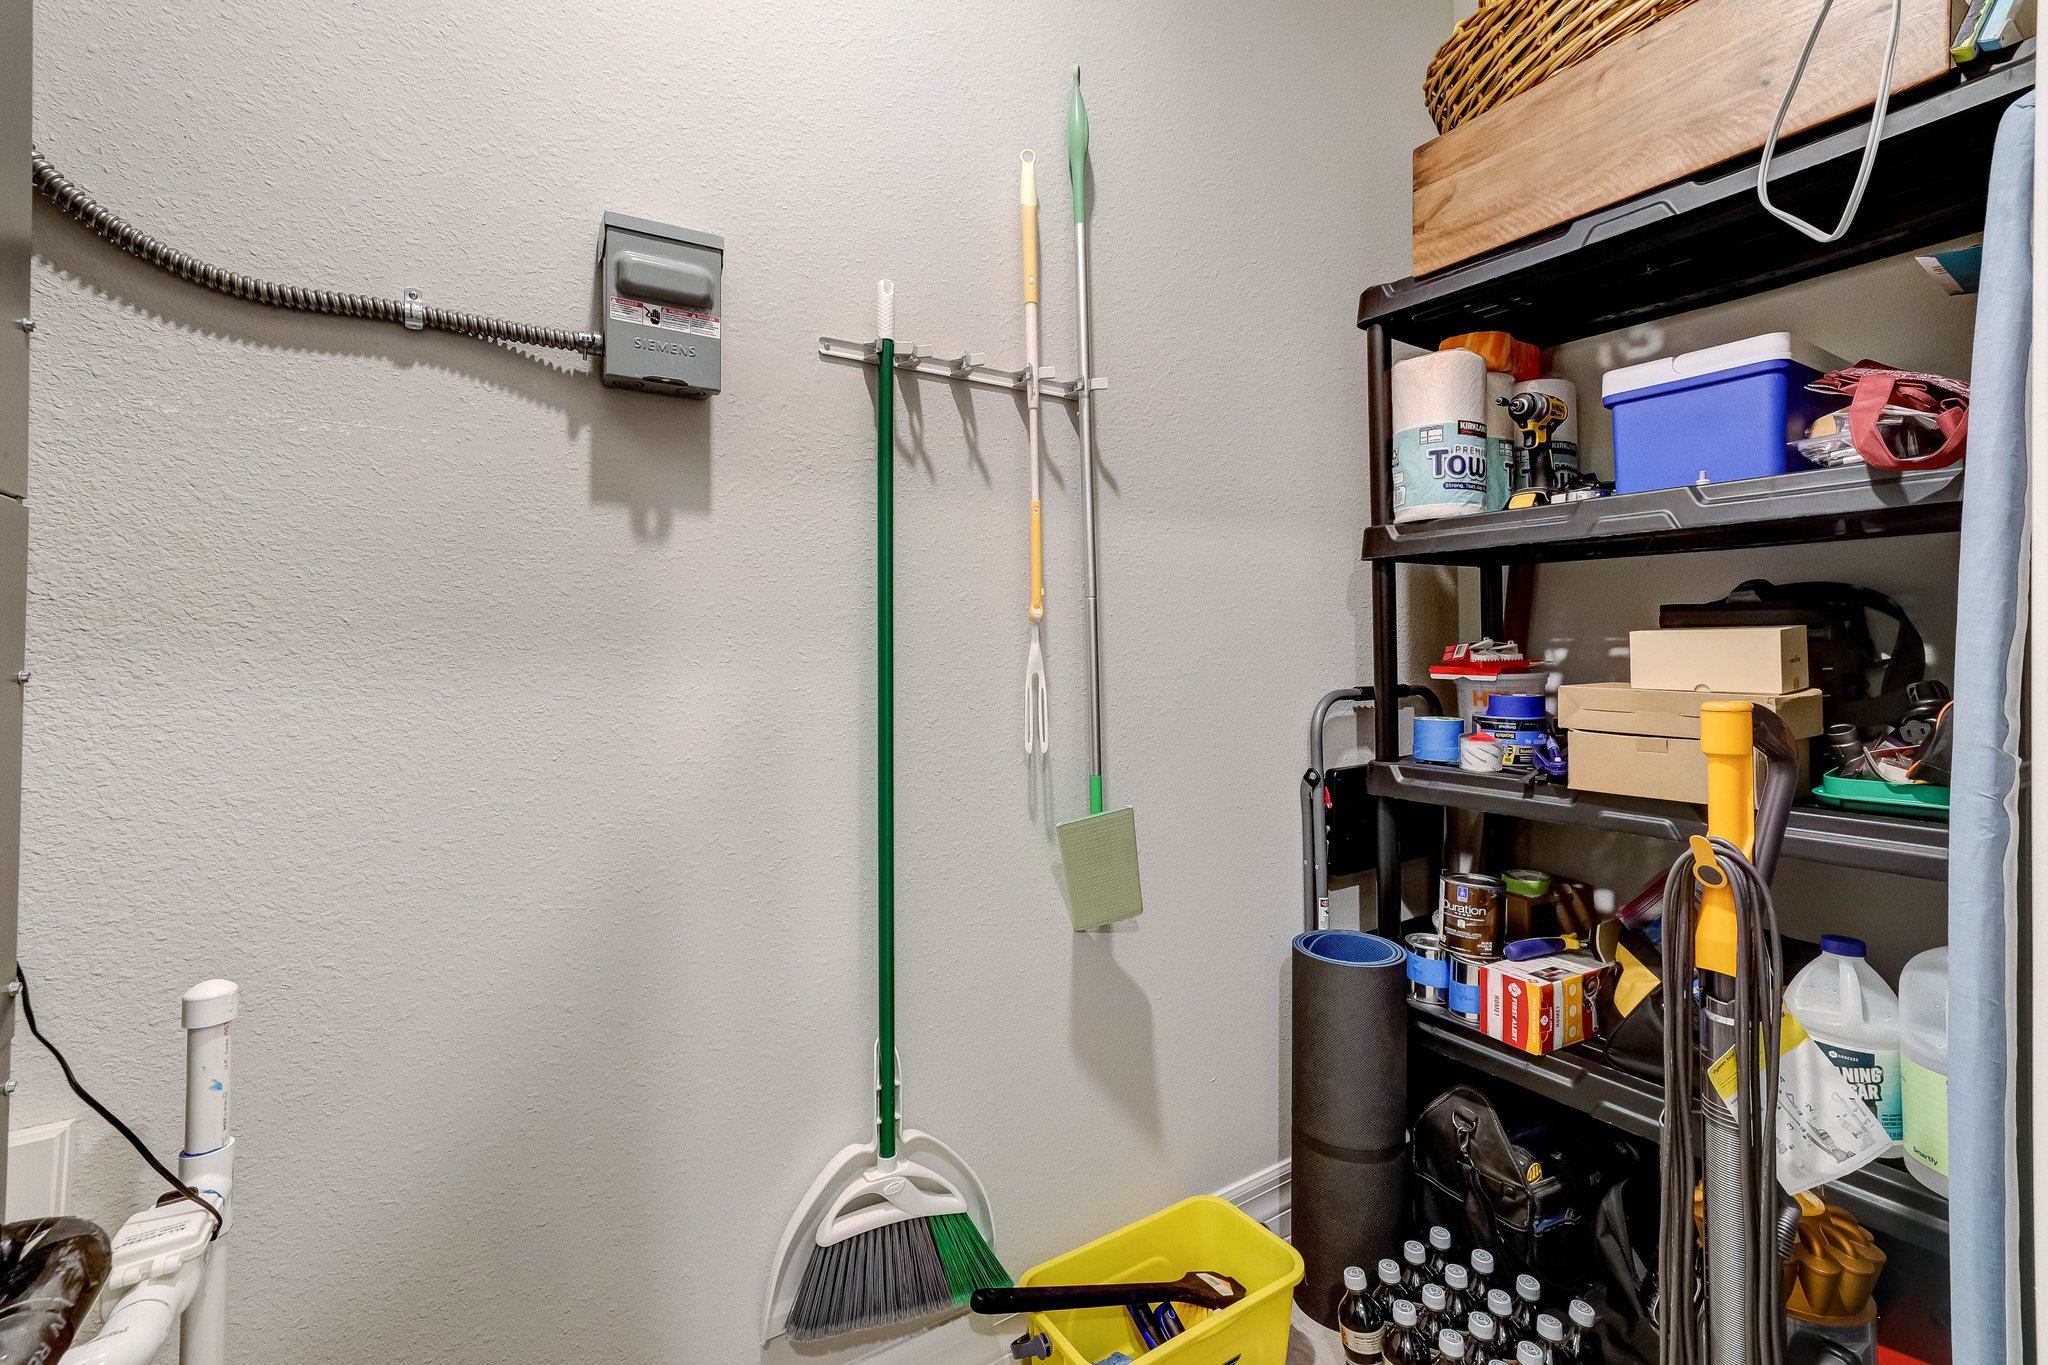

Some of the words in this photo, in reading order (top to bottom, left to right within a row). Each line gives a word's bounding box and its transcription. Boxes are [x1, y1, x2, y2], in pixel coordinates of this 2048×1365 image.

[633, 336, 697, 358] SIEMENS
[1443, 899, 1487, 916] Duration
[1841, 1066, 1883, 1084] NING
[1805, 1104, 1815, 1113] 2
[1786, 1122, 1795, 1131] 3
[1912, 1145, 1938, 1166] Smartly
